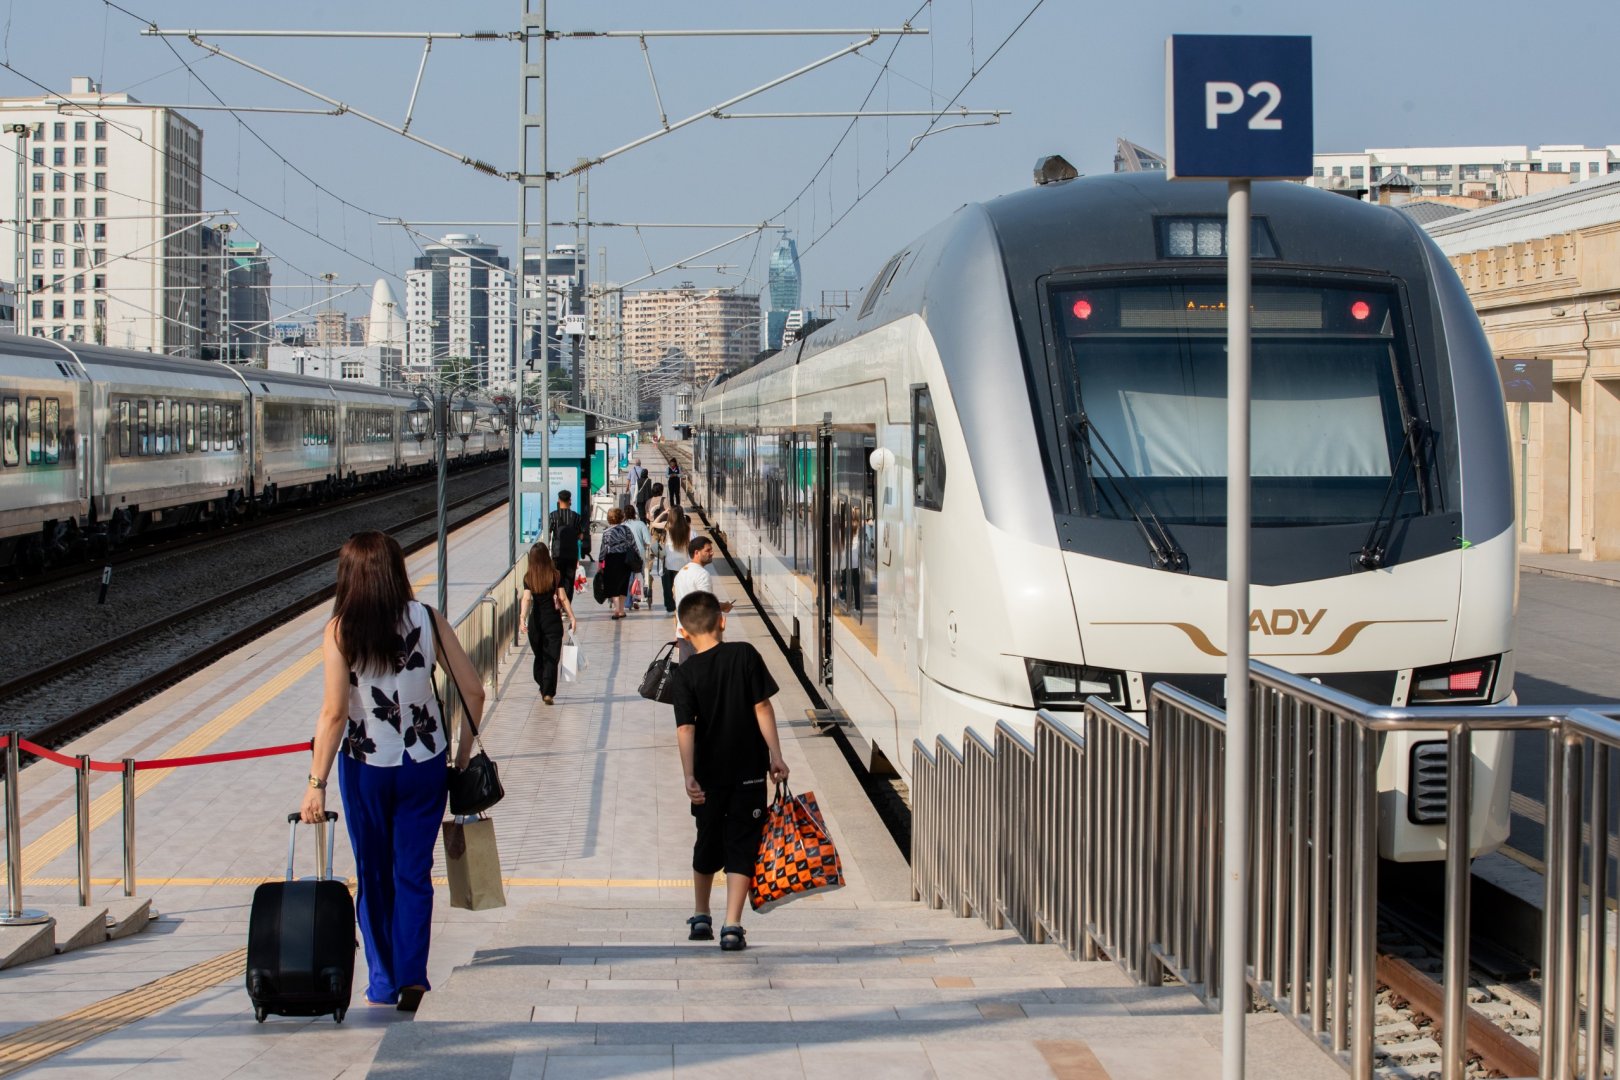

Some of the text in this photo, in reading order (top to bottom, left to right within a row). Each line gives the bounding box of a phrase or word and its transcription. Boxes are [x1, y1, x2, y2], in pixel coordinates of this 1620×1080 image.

[1205, 81, 1282, 130] P2
[525, 358, 534, 371] 4
[1249, 608, 1328, 636] ADY
